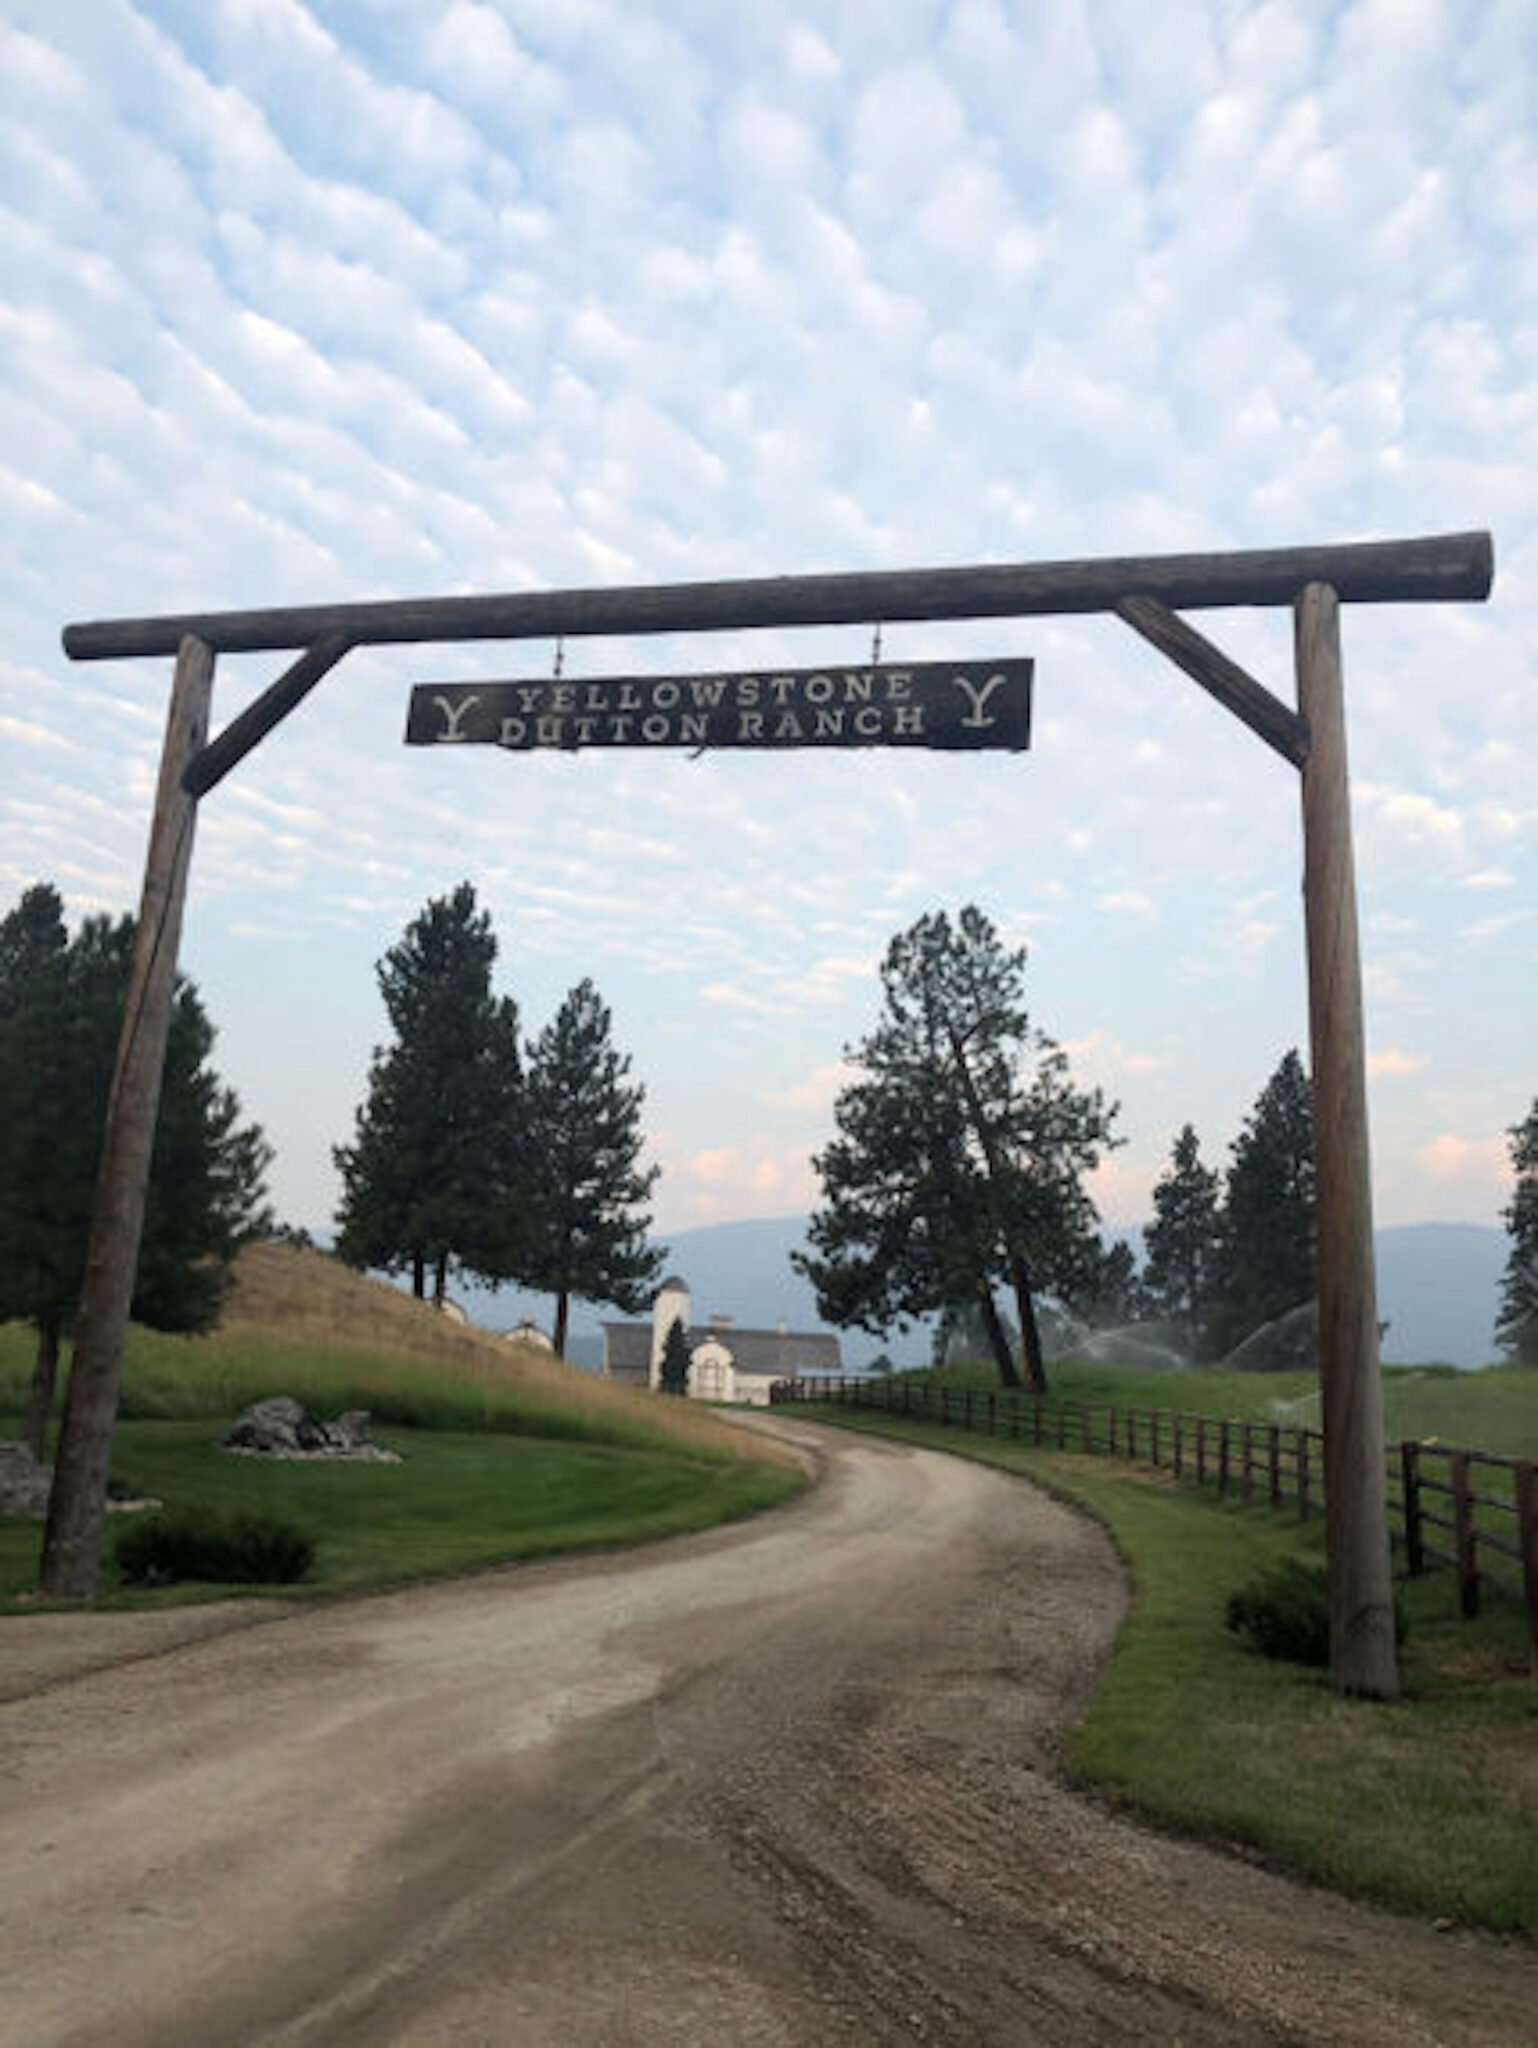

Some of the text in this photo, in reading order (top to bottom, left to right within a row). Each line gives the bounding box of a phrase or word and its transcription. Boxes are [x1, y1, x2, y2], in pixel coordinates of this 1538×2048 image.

[517, 673, 915, 713] YELLOWSTONE
[500, 706, 925, 744] DUTTON RANCH
